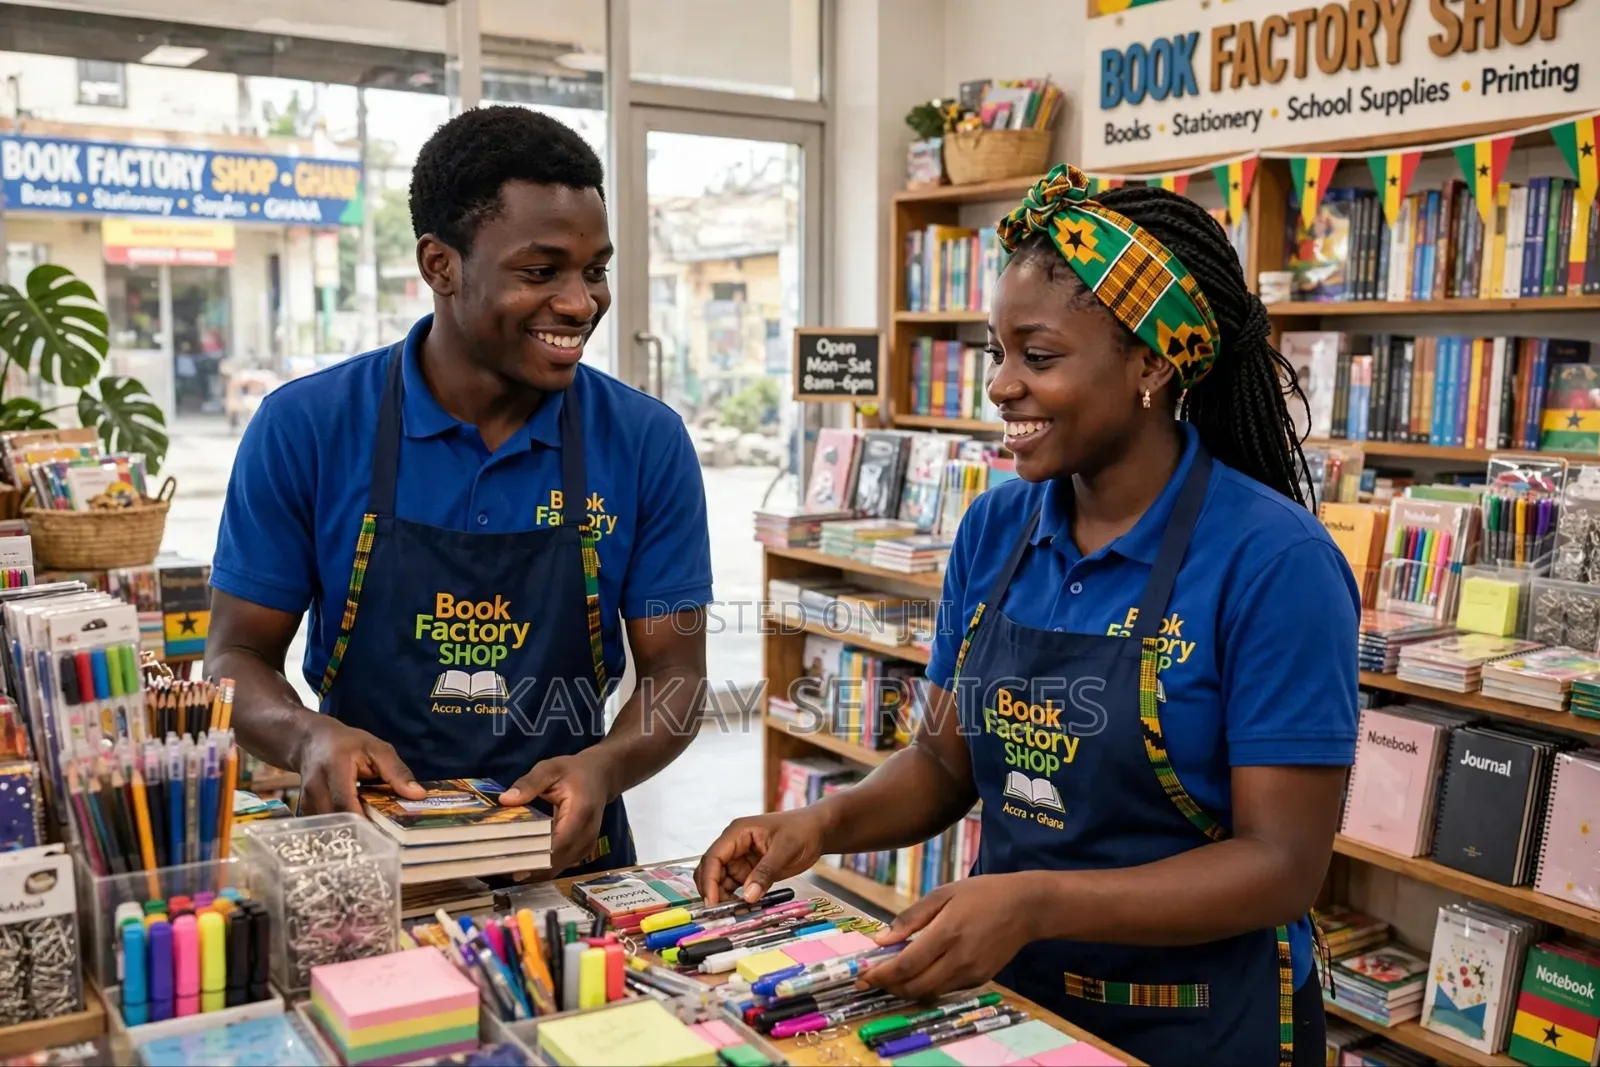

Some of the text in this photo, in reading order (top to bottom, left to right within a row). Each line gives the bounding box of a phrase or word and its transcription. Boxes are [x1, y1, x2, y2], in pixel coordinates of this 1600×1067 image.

[1100, 32, 1200, 110] BOOK
[1210, 0, 1410, 92] FACTORY
[1104, 59, 1580, 145] Books Stationery School Supplies Printing
[2, 140, 82, 183] BOOK
[86, 145, 206, 191] FACTORY
[211, 155, 278, 196] SHOP
[20, 182, 73, 207] Books
[816, 337, 857, 358] Open
[436, 592, 511, 621] Book
[415, 614, 531, 649] Factory
[439, 642, 508, 668] SHOP
[431, 702, 508, 715] Accra Ghana
[998, 688, 1062, 729] Book
[984, 708, 1079, 763] Factory
[1367, 730, 1418, 756] Notebook
[1004, 742, 1060, 776] SHOP
[1460, 750, 1512, 777] Journal
[1003, 802, 1064, 830] Accra Ghana
[1535, 964, 1596, 1000] Notebook
